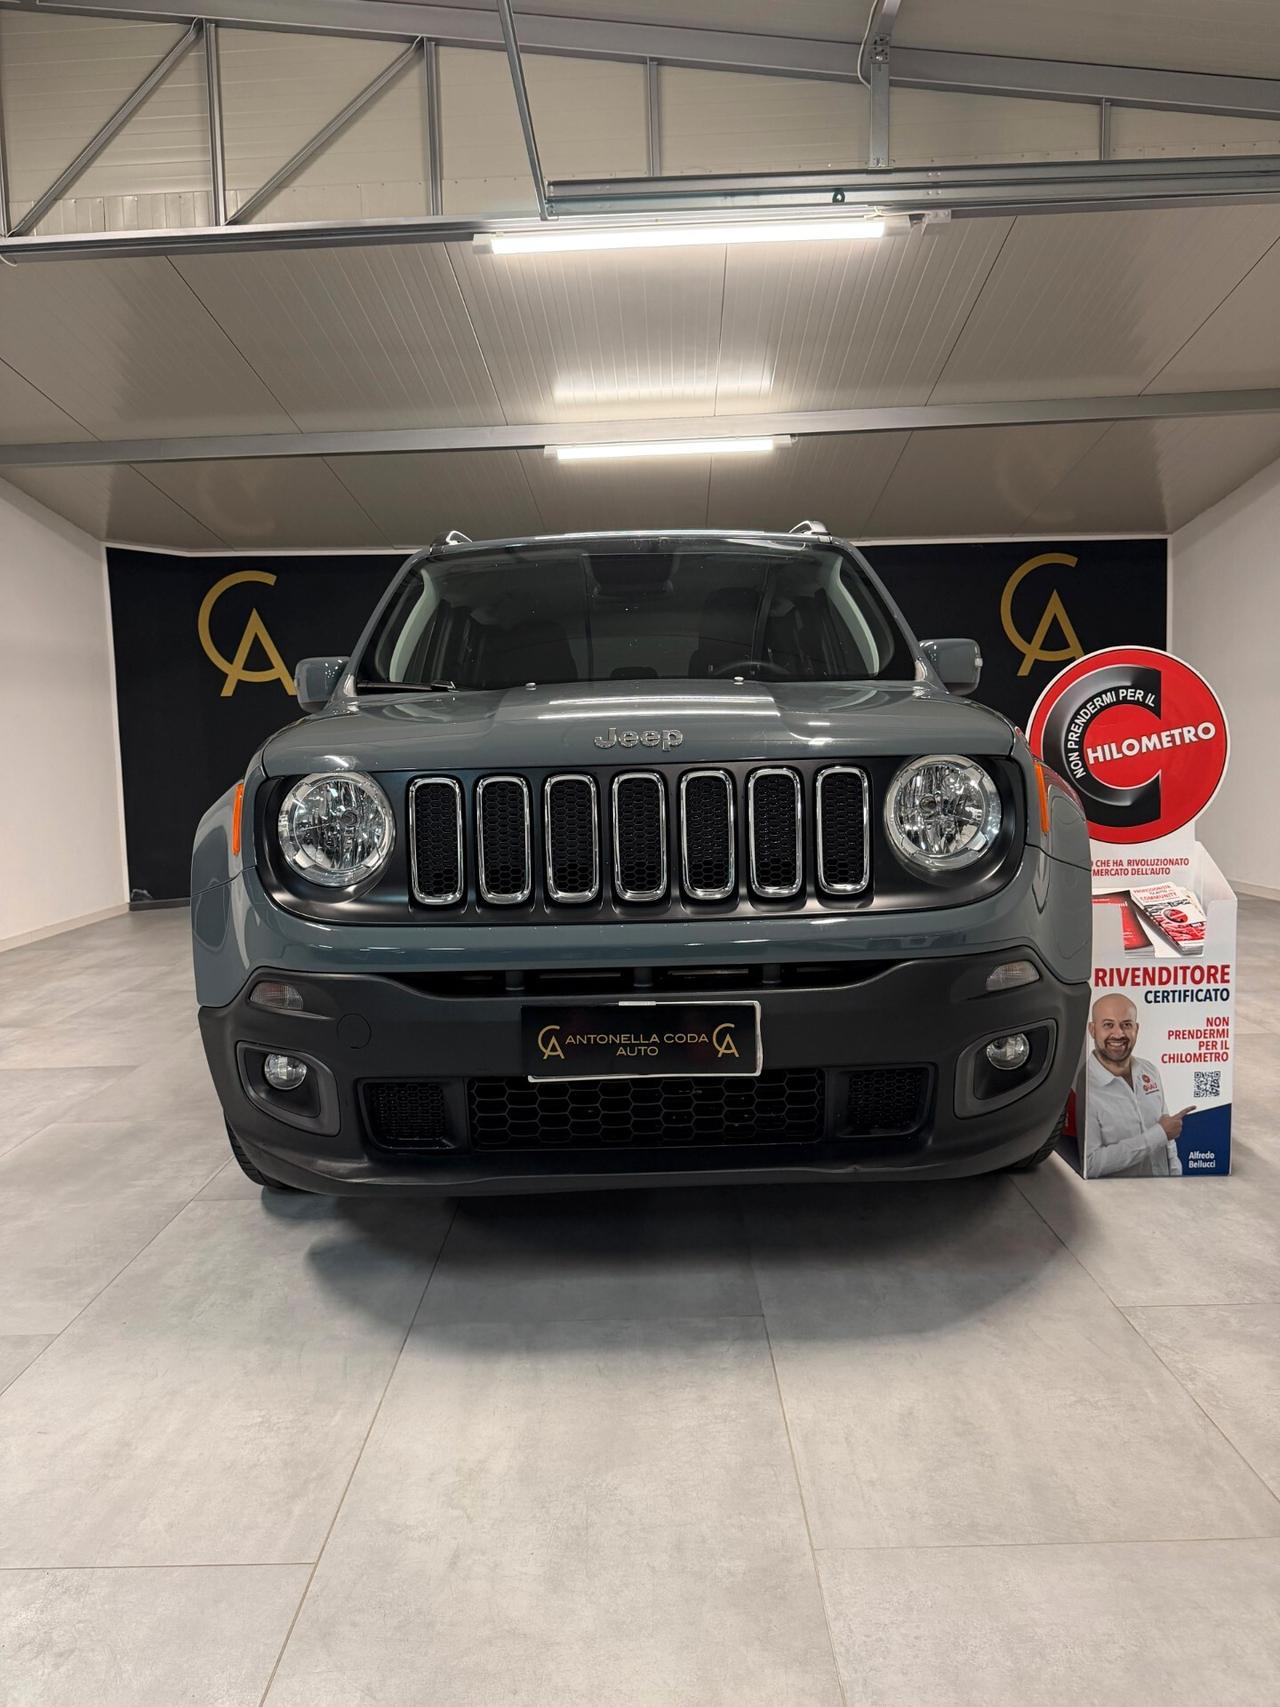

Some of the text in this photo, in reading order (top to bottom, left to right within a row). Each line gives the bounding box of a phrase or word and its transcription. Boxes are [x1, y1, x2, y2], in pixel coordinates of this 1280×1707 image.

[1068, 689, 1157, 778] NON PRENDERMI PER IL
[593, 727, 684, 752] Jeep
[1095, 859, 1110, 868] CHE
[1112, 859, 1124, 868] HA
[1126, 857, 1190, 867] RIVOLUZIONATO
[1092, 867, 1171, 877] MERCATO DELL'AUTO
[1094, 964, 1231, 987] RIVENDITORE
[1144, 988, 1230, 1004] CERTIFICATO
[1206, 1016, 1230, 1027] NON
[565, 1034, 660, 1045] ANTONELLA
[663, 1033, 709, 1044] CODA
[1167, 1028, 1229, 1040] PRENDERMI
[1198, 1040, 1230, 1050] PER IL
[616, 1047, 659, 1056] AUTO
[1161, 1051, 1229, 1064] CHILOMETRO
[1188, 1151, 1215, 1160] Alfredo
[1188, 1160, 1216, 1169] Bellucci
